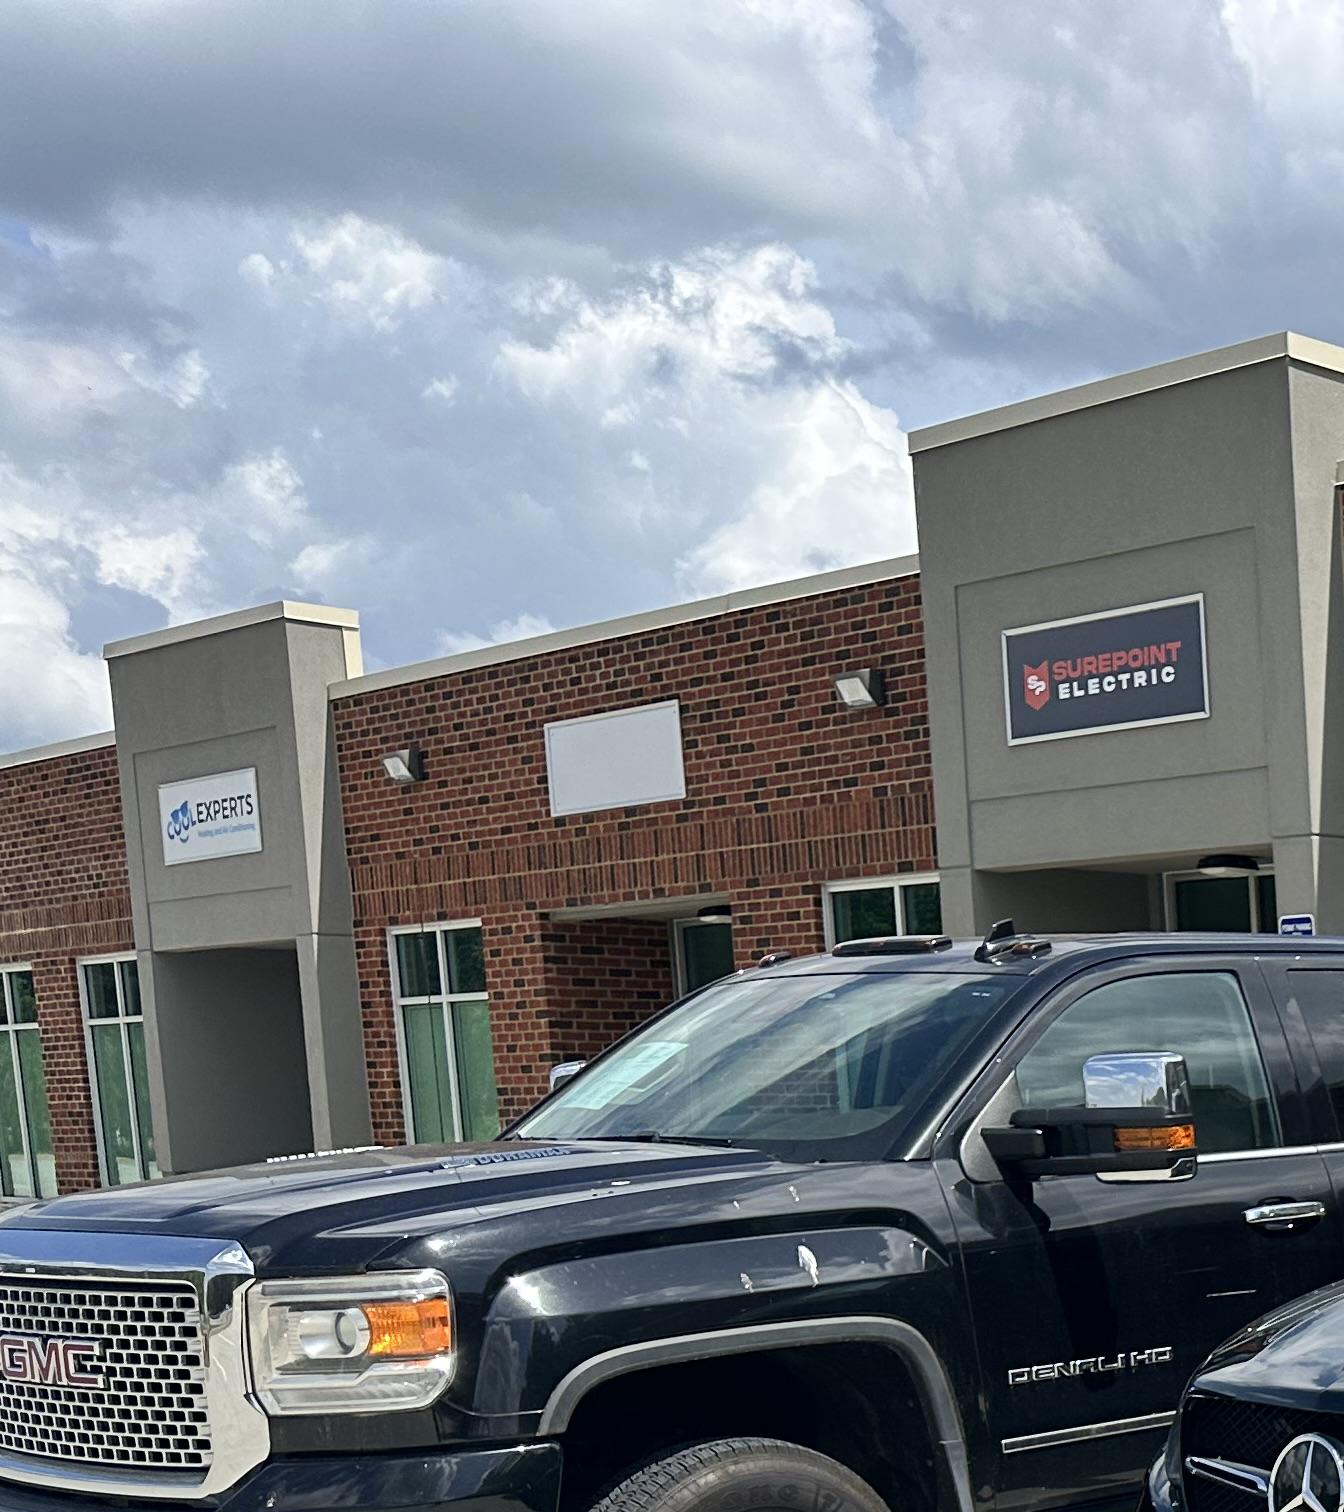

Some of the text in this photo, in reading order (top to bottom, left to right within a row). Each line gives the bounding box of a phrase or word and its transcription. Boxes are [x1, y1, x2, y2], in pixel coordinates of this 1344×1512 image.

[1052, 640, 1182, 681] SUREPOINT
[1057, 665, 1176, 700] ELECTRIC
[196, 793, 254, 824] EXPERTS
[0, 1334, 105, 1389] GMC
[1008, 1346, 1173, 1385] DENALI HD
